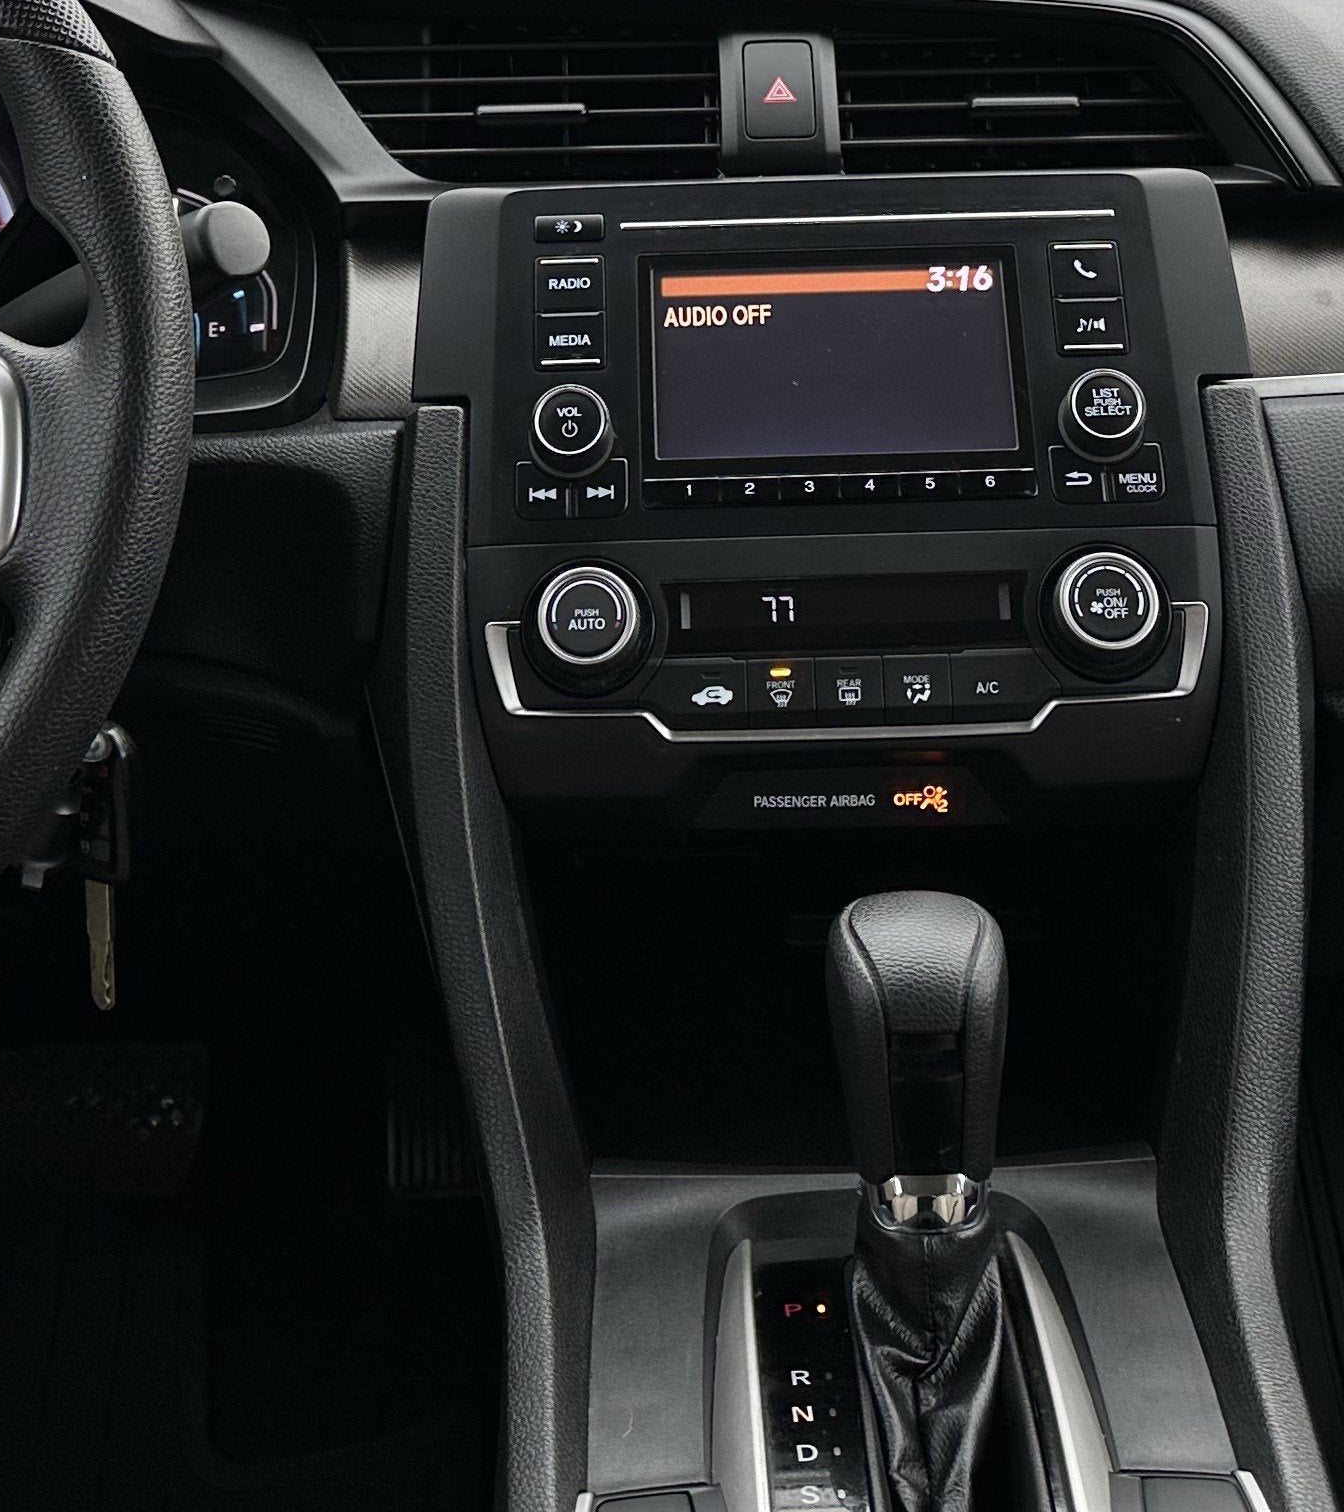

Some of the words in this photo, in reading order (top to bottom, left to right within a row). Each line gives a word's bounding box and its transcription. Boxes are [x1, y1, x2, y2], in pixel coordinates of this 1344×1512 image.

[548, 277, 592, 291] RADIO
[925, 264, 994, 293] 3:16
[663, 305, 728, 328] AUDIO
[731, 303, 773, 326] OFF
[208, 321, 219, 338] E
[548, 334, 592, 348] MEDIA
[1091, 387, 1120, 399] LIST
[1093, 398, 1122, 407] PUSH
[557, 406, 583, 418] VOL
[1084, 405, 1133, 417] SELECT
[864, 478, 876, 492] 4
[924, 477, 936, 490] 5
[984, 475, 996, 488] 6
[1118, 472, 1158, 484] MENU
[685, 483, 693, 497] 1
[743, 482, 756, 496] 2
[803, 480, 816, 494] 3
[1126, 484, 1158, 494] CLOCK
[1095, 588, 1121, 597] PUSH
[574, 608, 600, 617] PUSH
[761, 595, 795, 624] 77
[1104, 607, 1129, 619] OFF
[568, 617, 606, 631] AUTO
[765, 680, 797, 690] FRONT
[836, 678, 862, 688] REAR
[902, 674, 931, 684] MODE
[975, 681, 1000, 694] A/C
[753, 795, 827, 808] PASSENGER
[829, 793, 876, 807] AIRBAG
[893, 792, 923, 806] OFF
[783, 1303, 802, 1318] P
[790, 1370, 812, 1386] R
[791, 1405, 815, 1423] N
[795, 1444, 819, 1462] D
[800, 1485, 821, 1504] S
